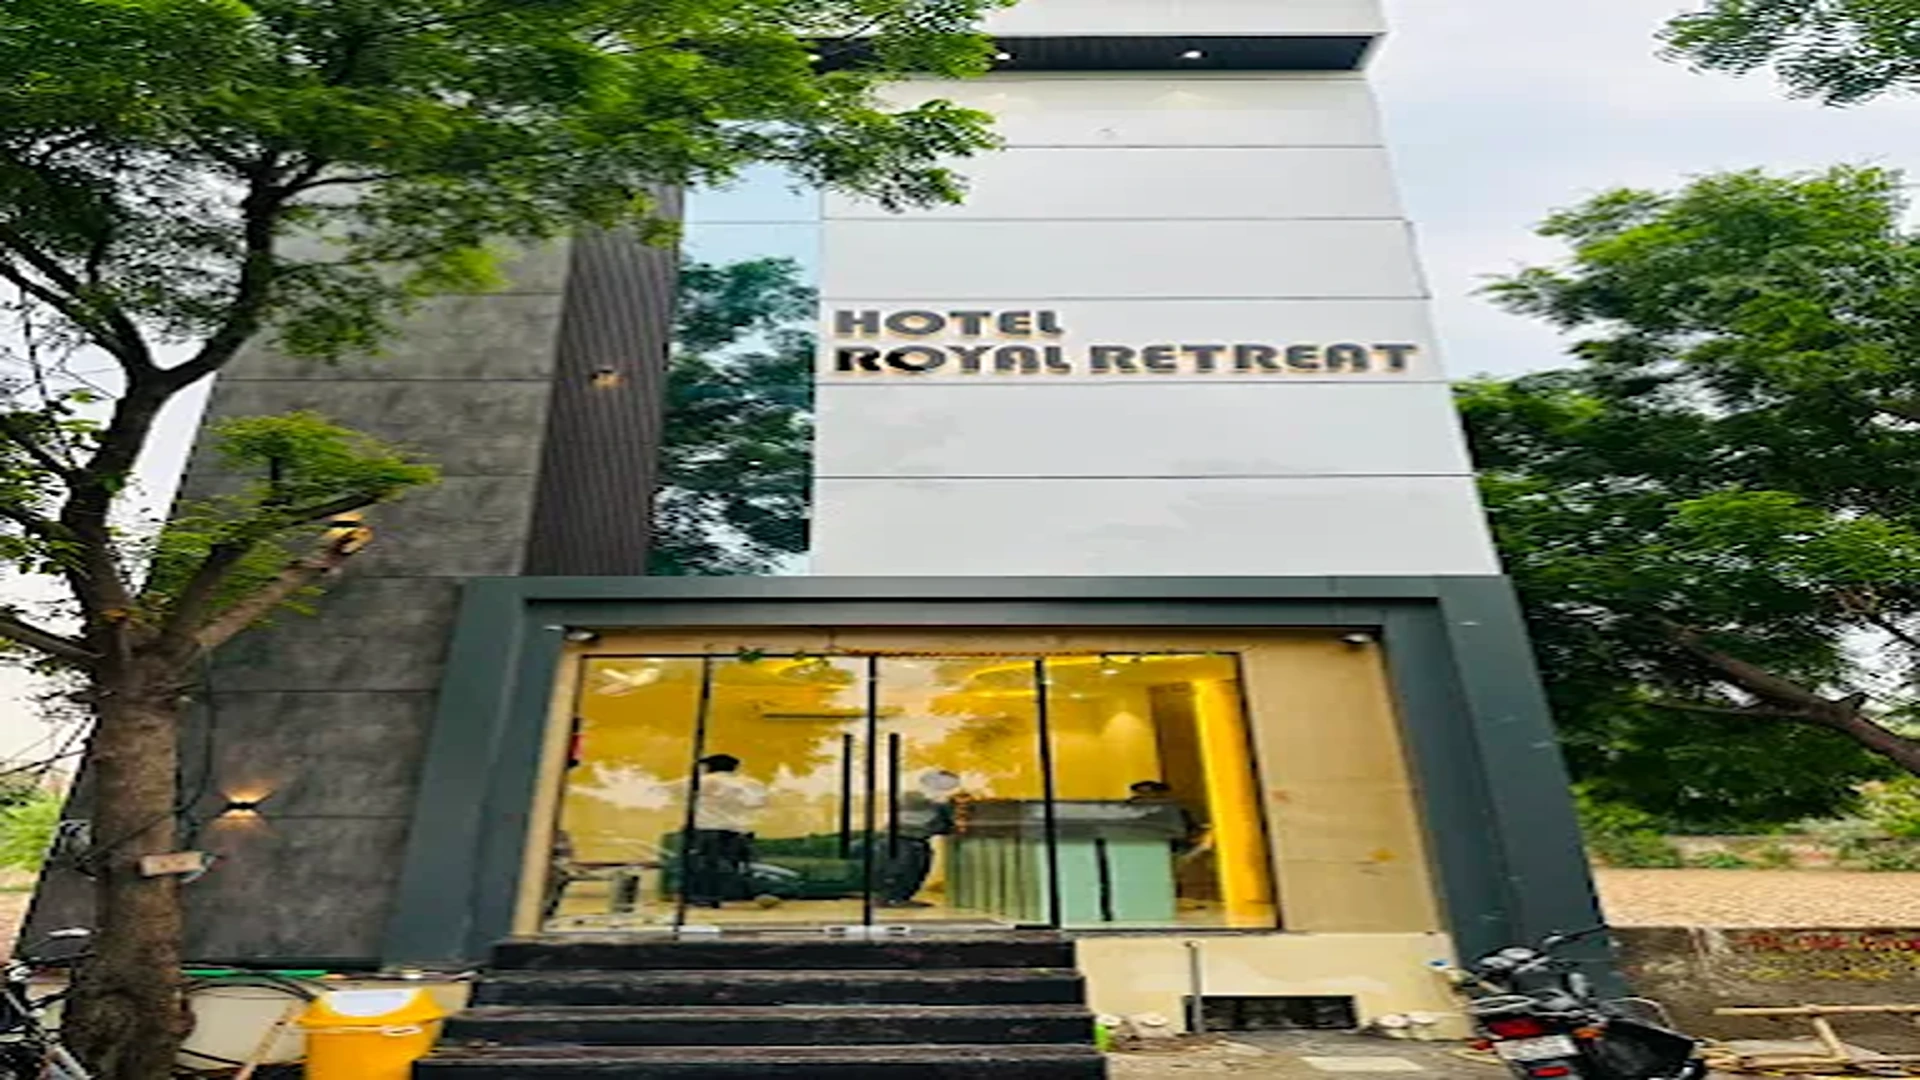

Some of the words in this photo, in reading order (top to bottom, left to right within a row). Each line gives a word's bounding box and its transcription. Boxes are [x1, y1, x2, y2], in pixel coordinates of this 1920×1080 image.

[834, 309, 1063, 338] HOTEL
[834, 345, 1071, 375] ROYAL
[1090, 343, 1417, 374] RETREAT
